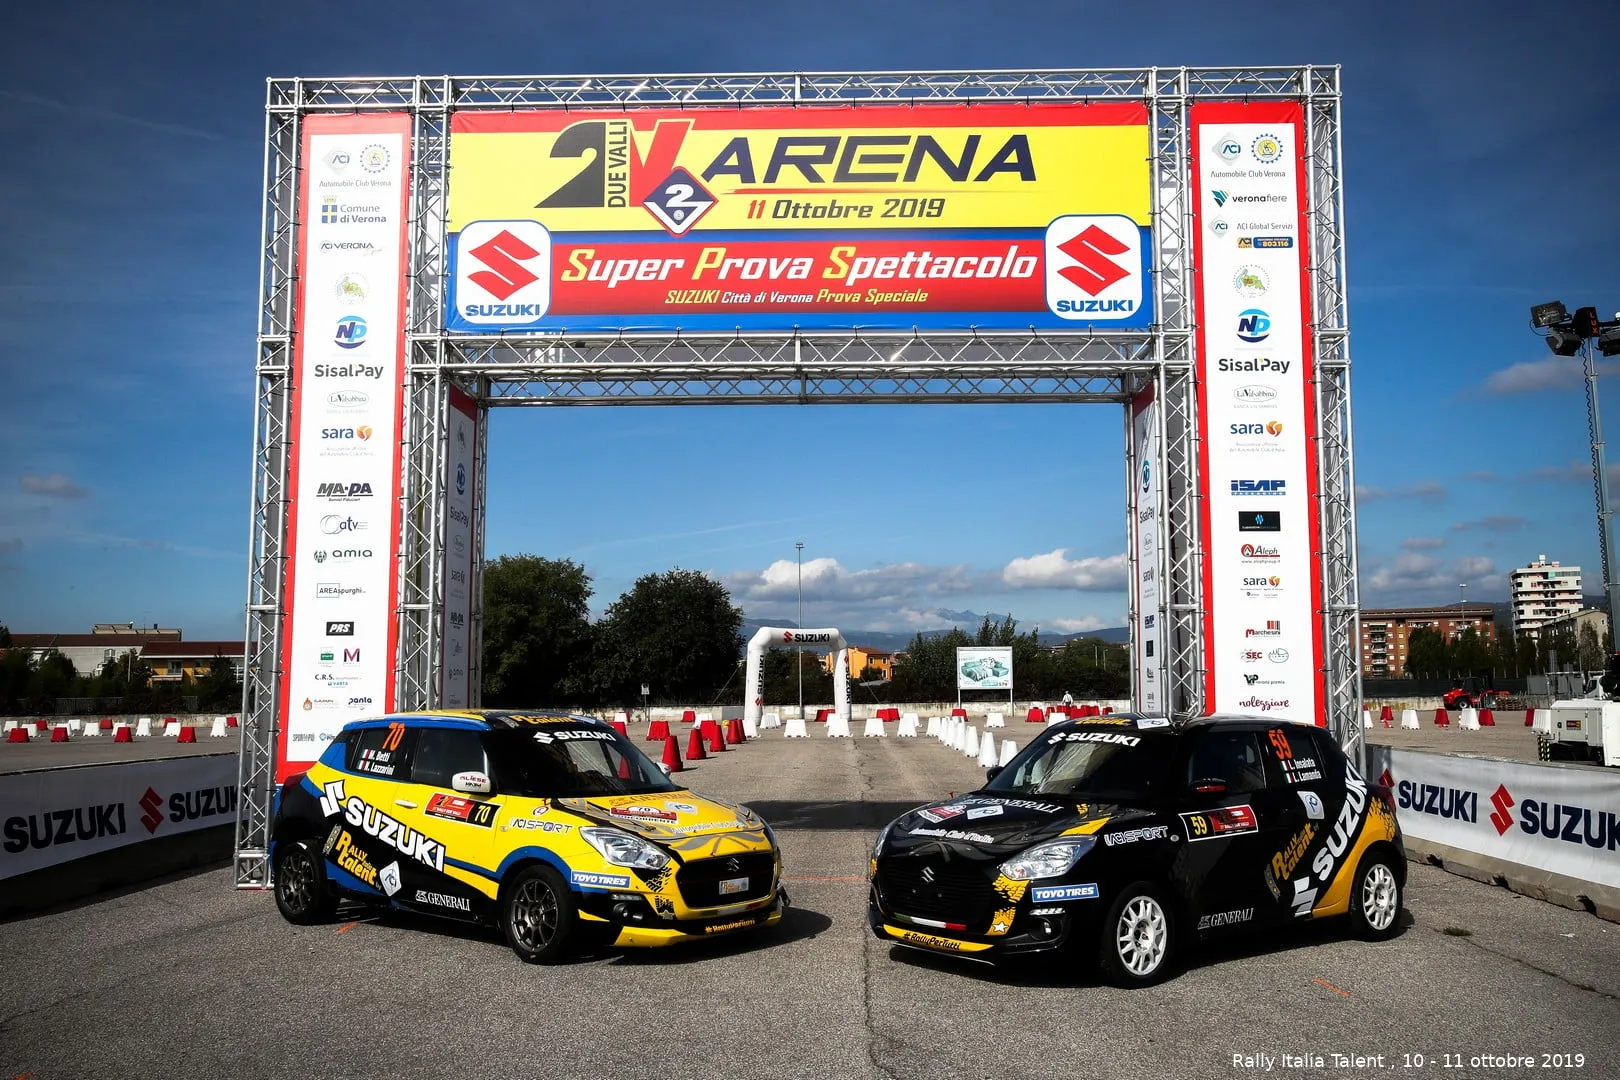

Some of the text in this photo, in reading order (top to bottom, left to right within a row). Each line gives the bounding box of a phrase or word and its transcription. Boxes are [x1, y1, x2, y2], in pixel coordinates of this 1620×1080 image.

[1223, 145, 1241, 154] ACI
[332, 155, 350, 164] ACI
[608, 121, 627, 207] DUE VALLI
[700, 134, 1036, 184] ARENA
[1232, 194, 1287, 203] veronafiere
[340, 204, 380, 213] Comune
[747, 198, 946, 219] 11 Ottobre 2019
[340, 215, 387, 223] di Verona
[1249, 222, 1270, 230] Global
[1271, 222, 1293, 230] Servizi
[334, 242, 374, 250] VERONA
[561, 245, 1039, 289] Super Prova Spettacolo
[665, 288, 928, 304] SUZUKI Città di Verona Prova Speciale
[465, 304, 540, 317] SUZUKI
[1056, 300, 1134, 313] SUZUKI
[314, 364, 384, 379] SisalPay
[1219, 358, 1290, 374] SisalPay
[321, 428, 354, 439] sara
[1230, 423, 1263, 434] sara
[340, 516, 359, 531] atv
[332, 549, 373, 557] amia
[1243, 577, 1267, 586] sara
[329, 624, 350, 633] PRS
[794, 634, 830, 643] SUZUKI
[1239, 696, 1289, 711] noleggiare
[382, 722, 405, 751] 70
[554, 730, 617, 741] SUZUKI
[1065, 732, 1141, 747] SUZUKI
[1268, 729, 1293, 760] 59
[977, 799, 1064, 813] GENERALI
[1398, 780, 1478, 824] SUZUKI
[474, 805, 491, 823] 70
[1312, 759, 1368, 881] SUZUKI
[3, 803, 126, 853] SUZUKI
[1190, 816, 1207, 835] 59
[345, 796, 446, 873] SUZUKI
[1283, 822, 1316, 880] talent
[338, 849, 377, 885] talent
[573, 873, 628, 886] TOYO TIRES
[1036, 887, 1095, 899] TOYO TIRES
[427, 892, 471, 911] GENERALI
[1211, 908, 1255, 928] GENERALI
